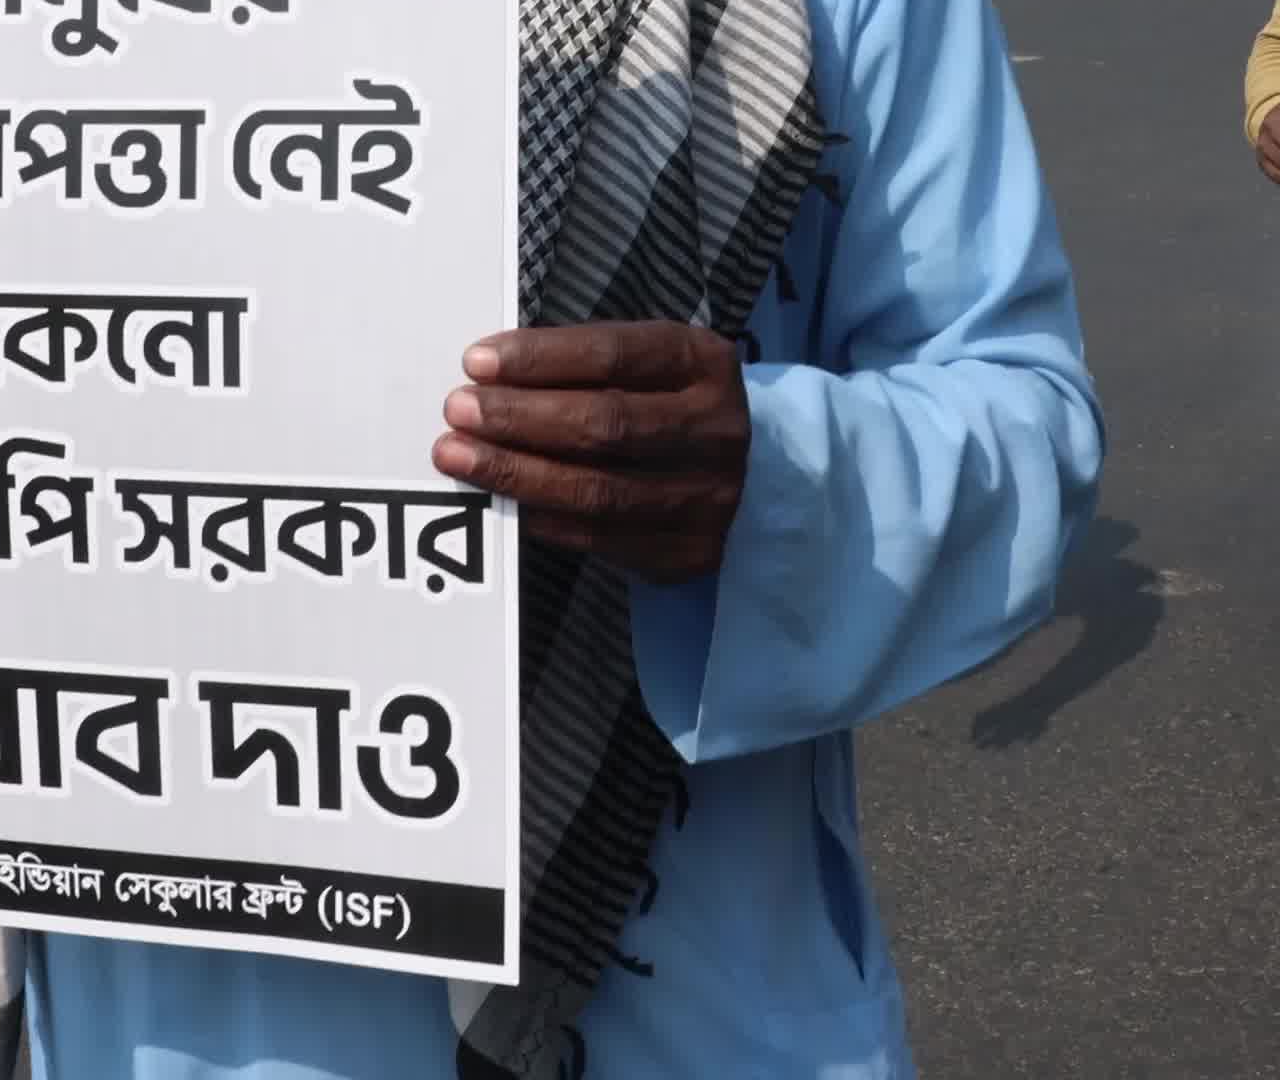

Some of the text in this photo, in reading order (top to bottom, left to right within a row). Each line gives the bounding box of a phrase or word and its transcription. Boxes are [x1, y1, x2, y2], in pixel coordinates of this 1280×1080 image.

[233, 78, 420, 214] নেই
[115, 479, 493, 593] সরকার
[198, 680, 460, 820] দাও
[114, 871, 237, 917] সেকুলার
[241, 874, 308, 919] ফ্রন্ট
[317, 885, 411, 941] (ISF)
